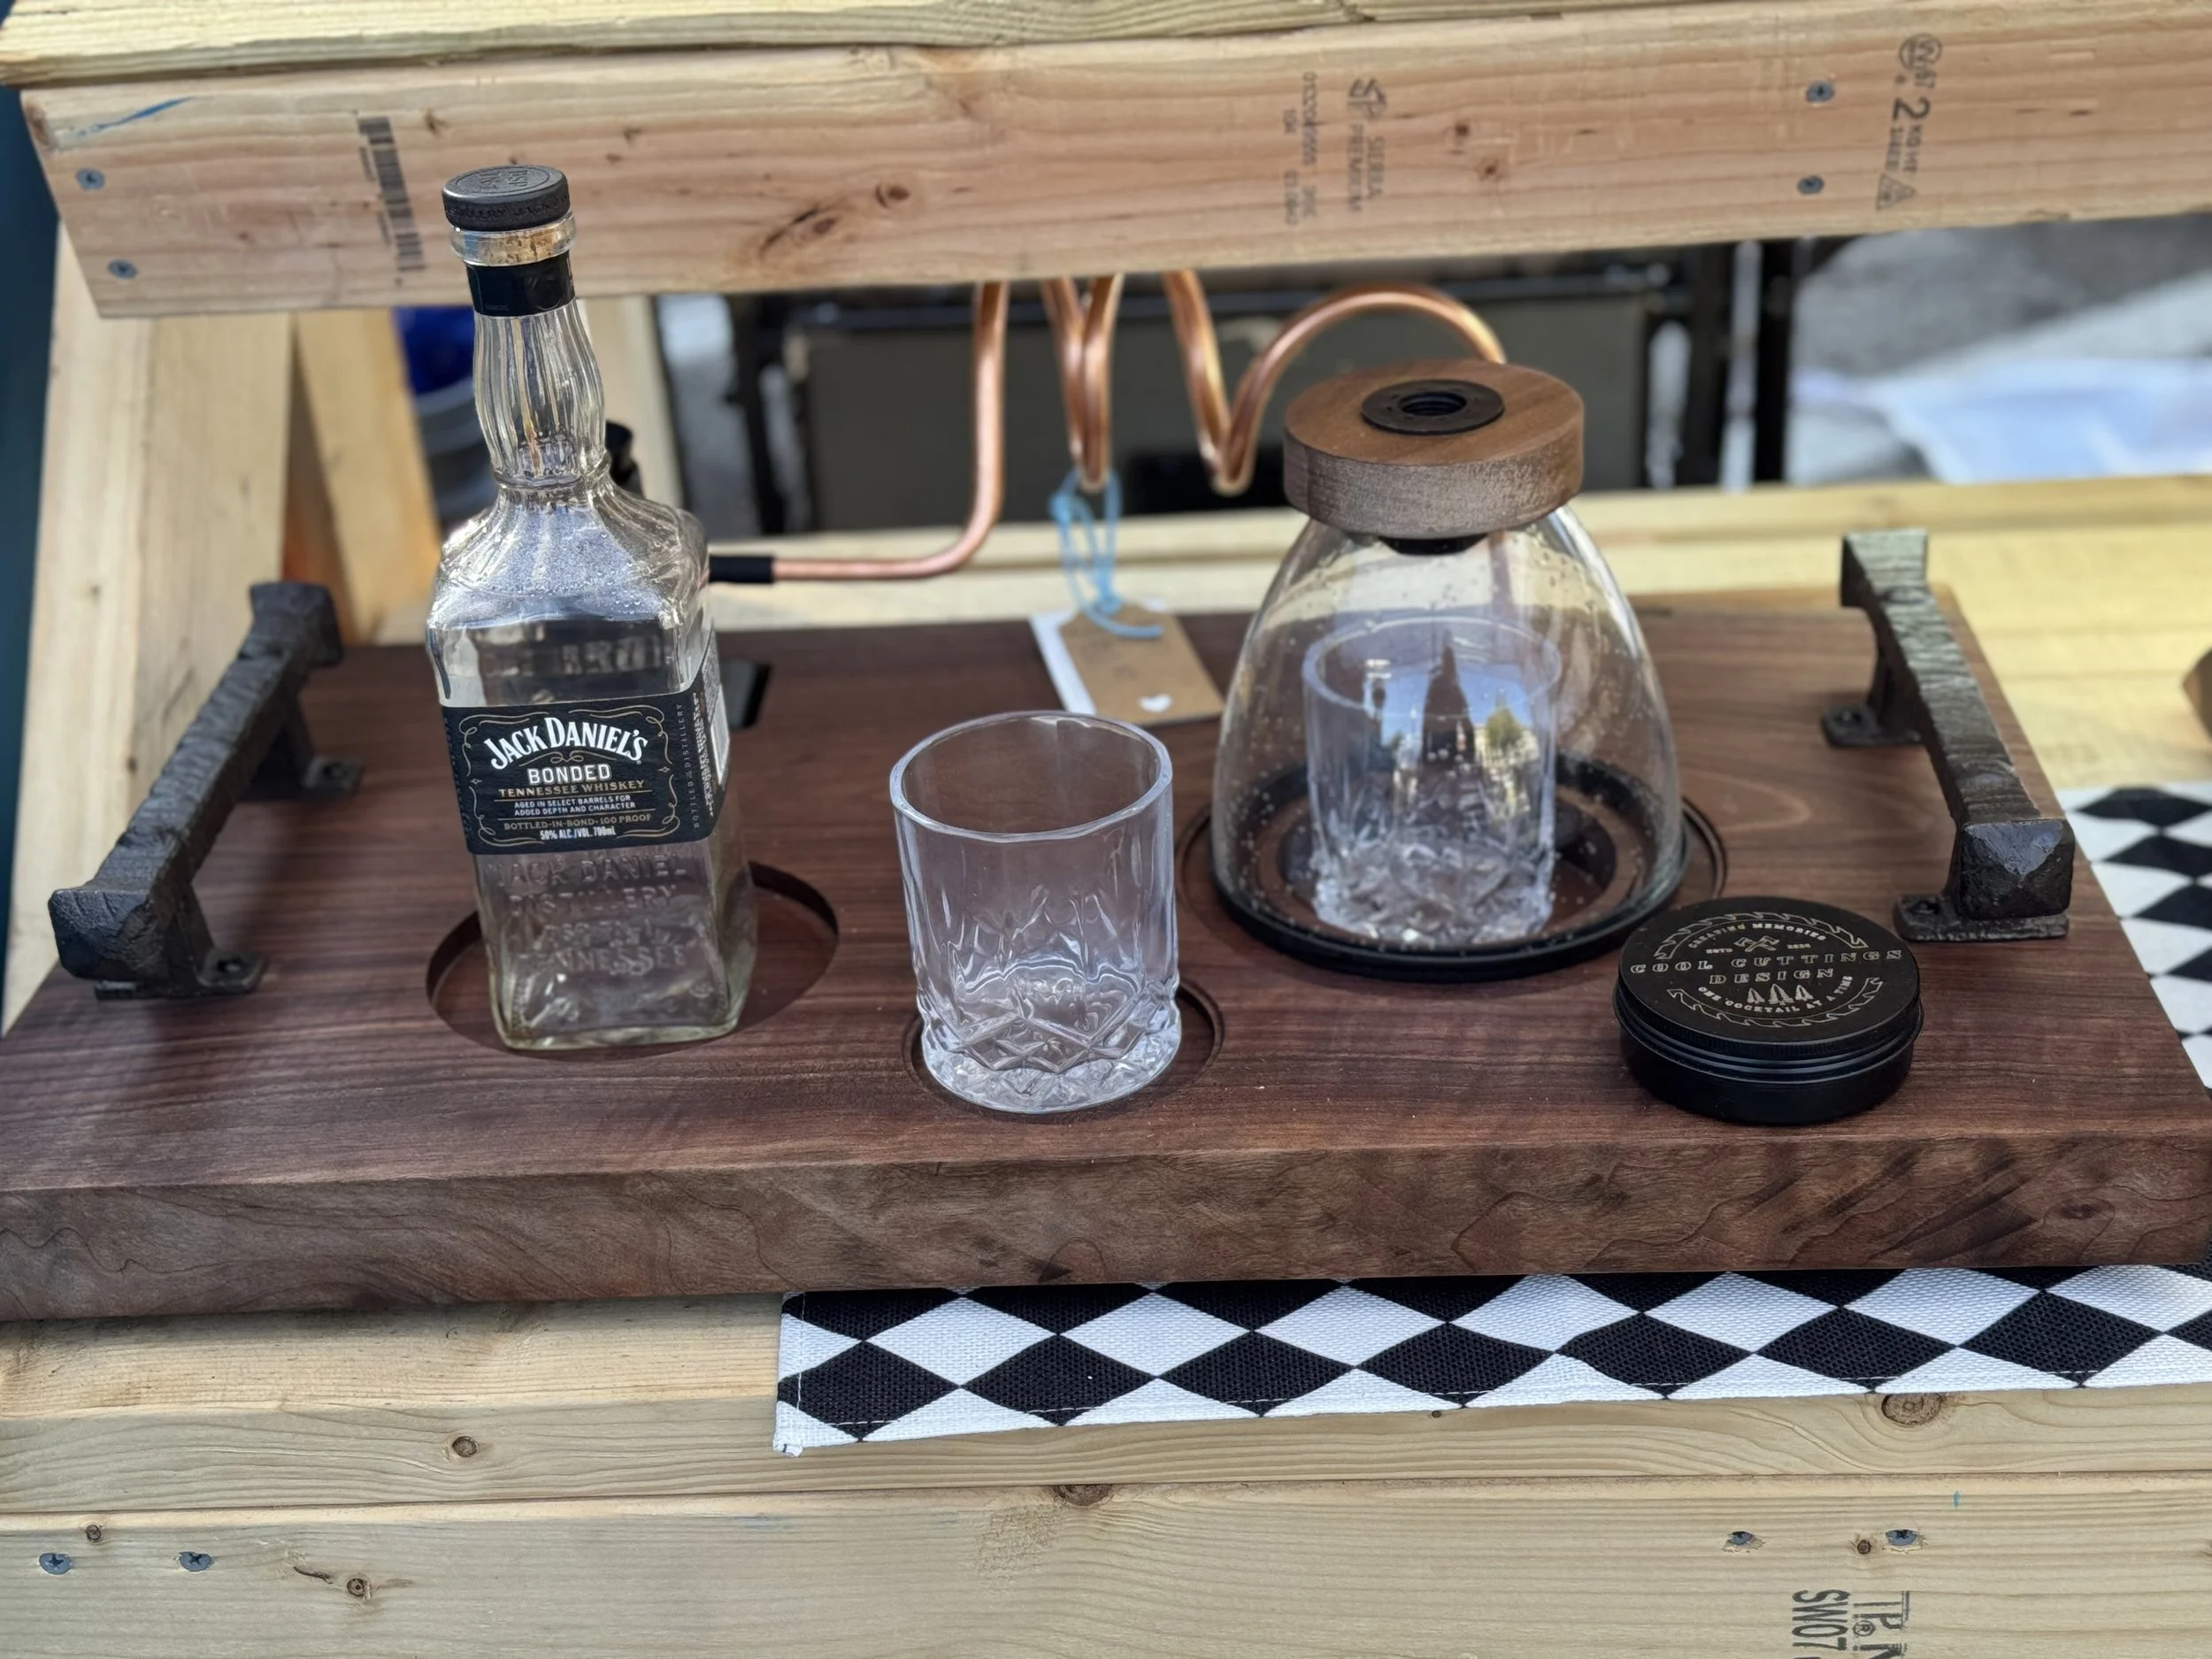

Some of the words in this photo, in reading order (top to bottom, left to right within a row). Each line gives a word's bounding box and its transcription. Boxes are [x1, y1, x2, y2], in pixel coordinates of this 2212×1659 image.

[1892, 96, 1932, 121] 2
[484, 723, 541, 770] JACK
[544, 717, 649, 762] DANIEL'S
[676, 704, 692, 769] DISTILLERY
[526, 764, 612, 785] BONDED
[498, 785, 580, 797] TENNESSEE
[581, 780, 645, 793] WHISKEY
[578, 796, 614, 805] BARRELS
[588, 803, 636, 812] CHARACTER
[687, 781, 701, 829] BOTTLED
[600, 816, 618, 825] 100
[618, 813, 652, 824] PROOF
[540, 829, 558, 841] 50%
[1630, 959, 1714, 973] COOL
[1731, 949, 1902, 969] CUTTINGS
[1709, 968, 1834, 985] DESIGN
[1698, 987, 1722, 1002] ONE
[1724, 1000, 1800, 1013] COCKTAIL
[1806, 1000, 1823, 1010] AT
[1833, 975, 1854, 995] TIME
